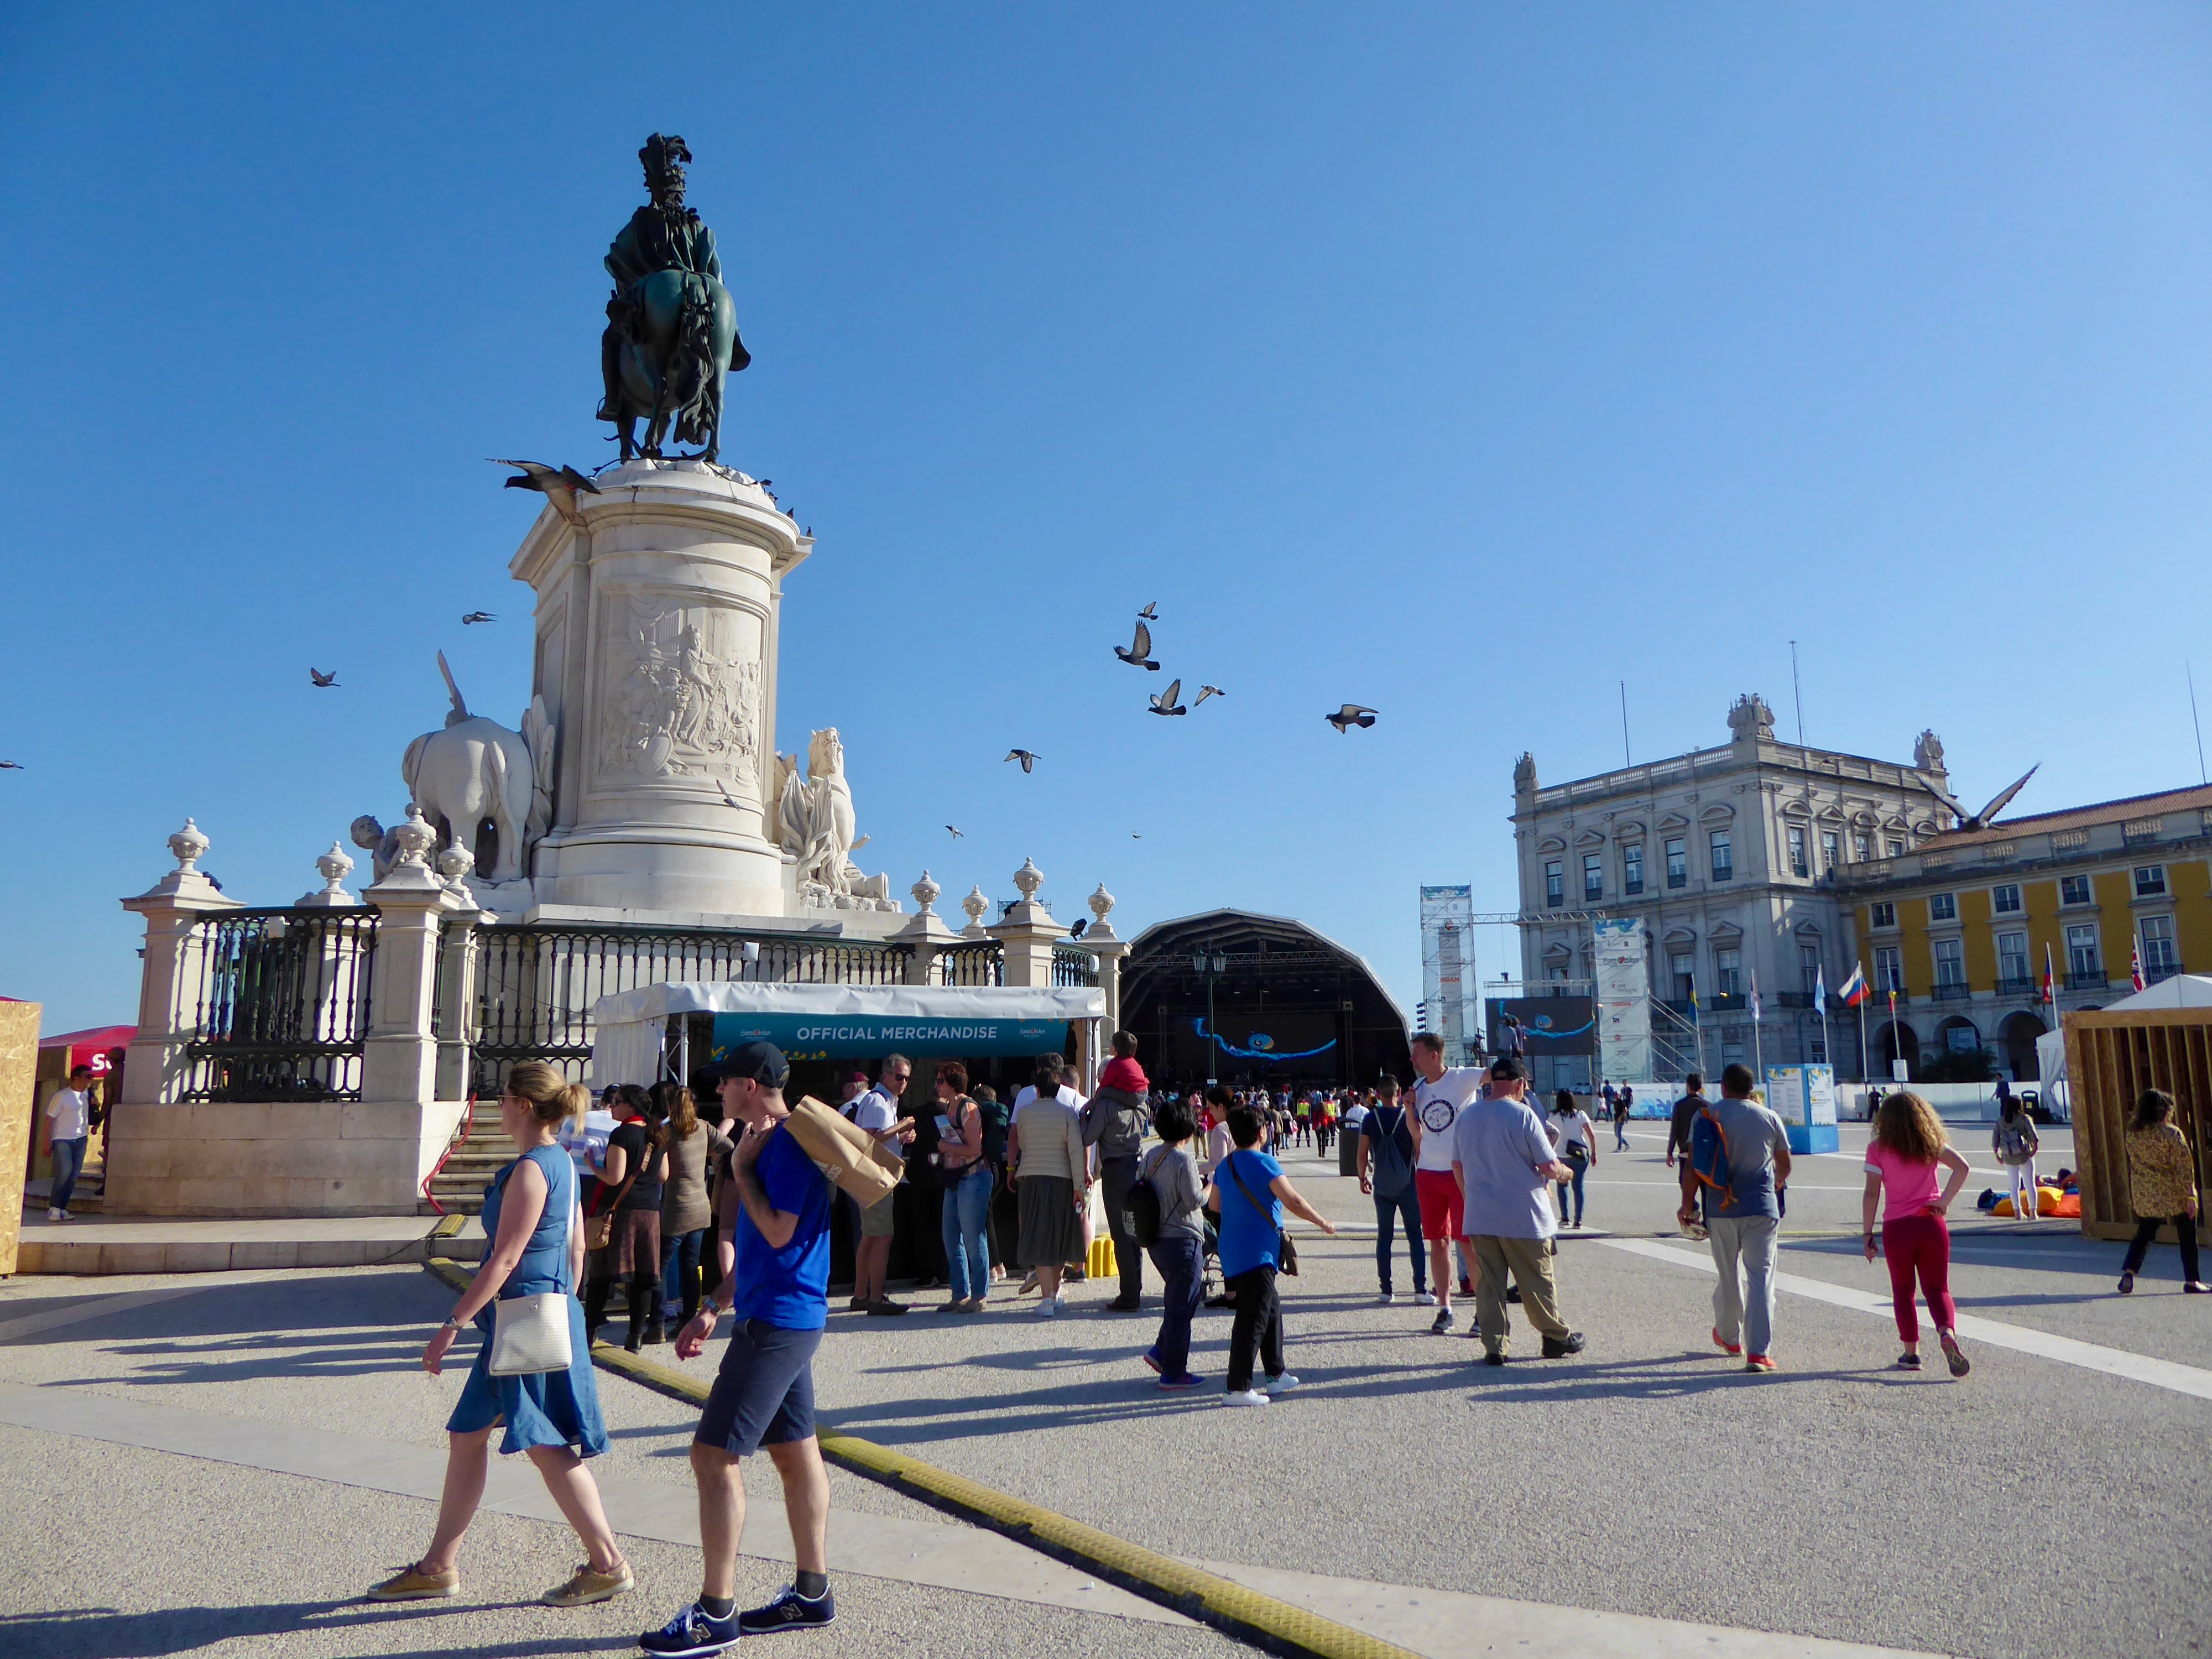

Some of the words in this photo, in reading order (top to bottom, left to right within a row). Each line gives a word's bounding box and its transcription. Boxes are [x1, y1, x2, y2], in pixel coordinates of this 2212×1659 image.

[796, 1026, 876, 1040] OFFICIAL
[881, 1026, 998, 1040] MERCHANDISE
[780, 1603, 804, 1621] N
[691, 1623, 712, 1644] N
